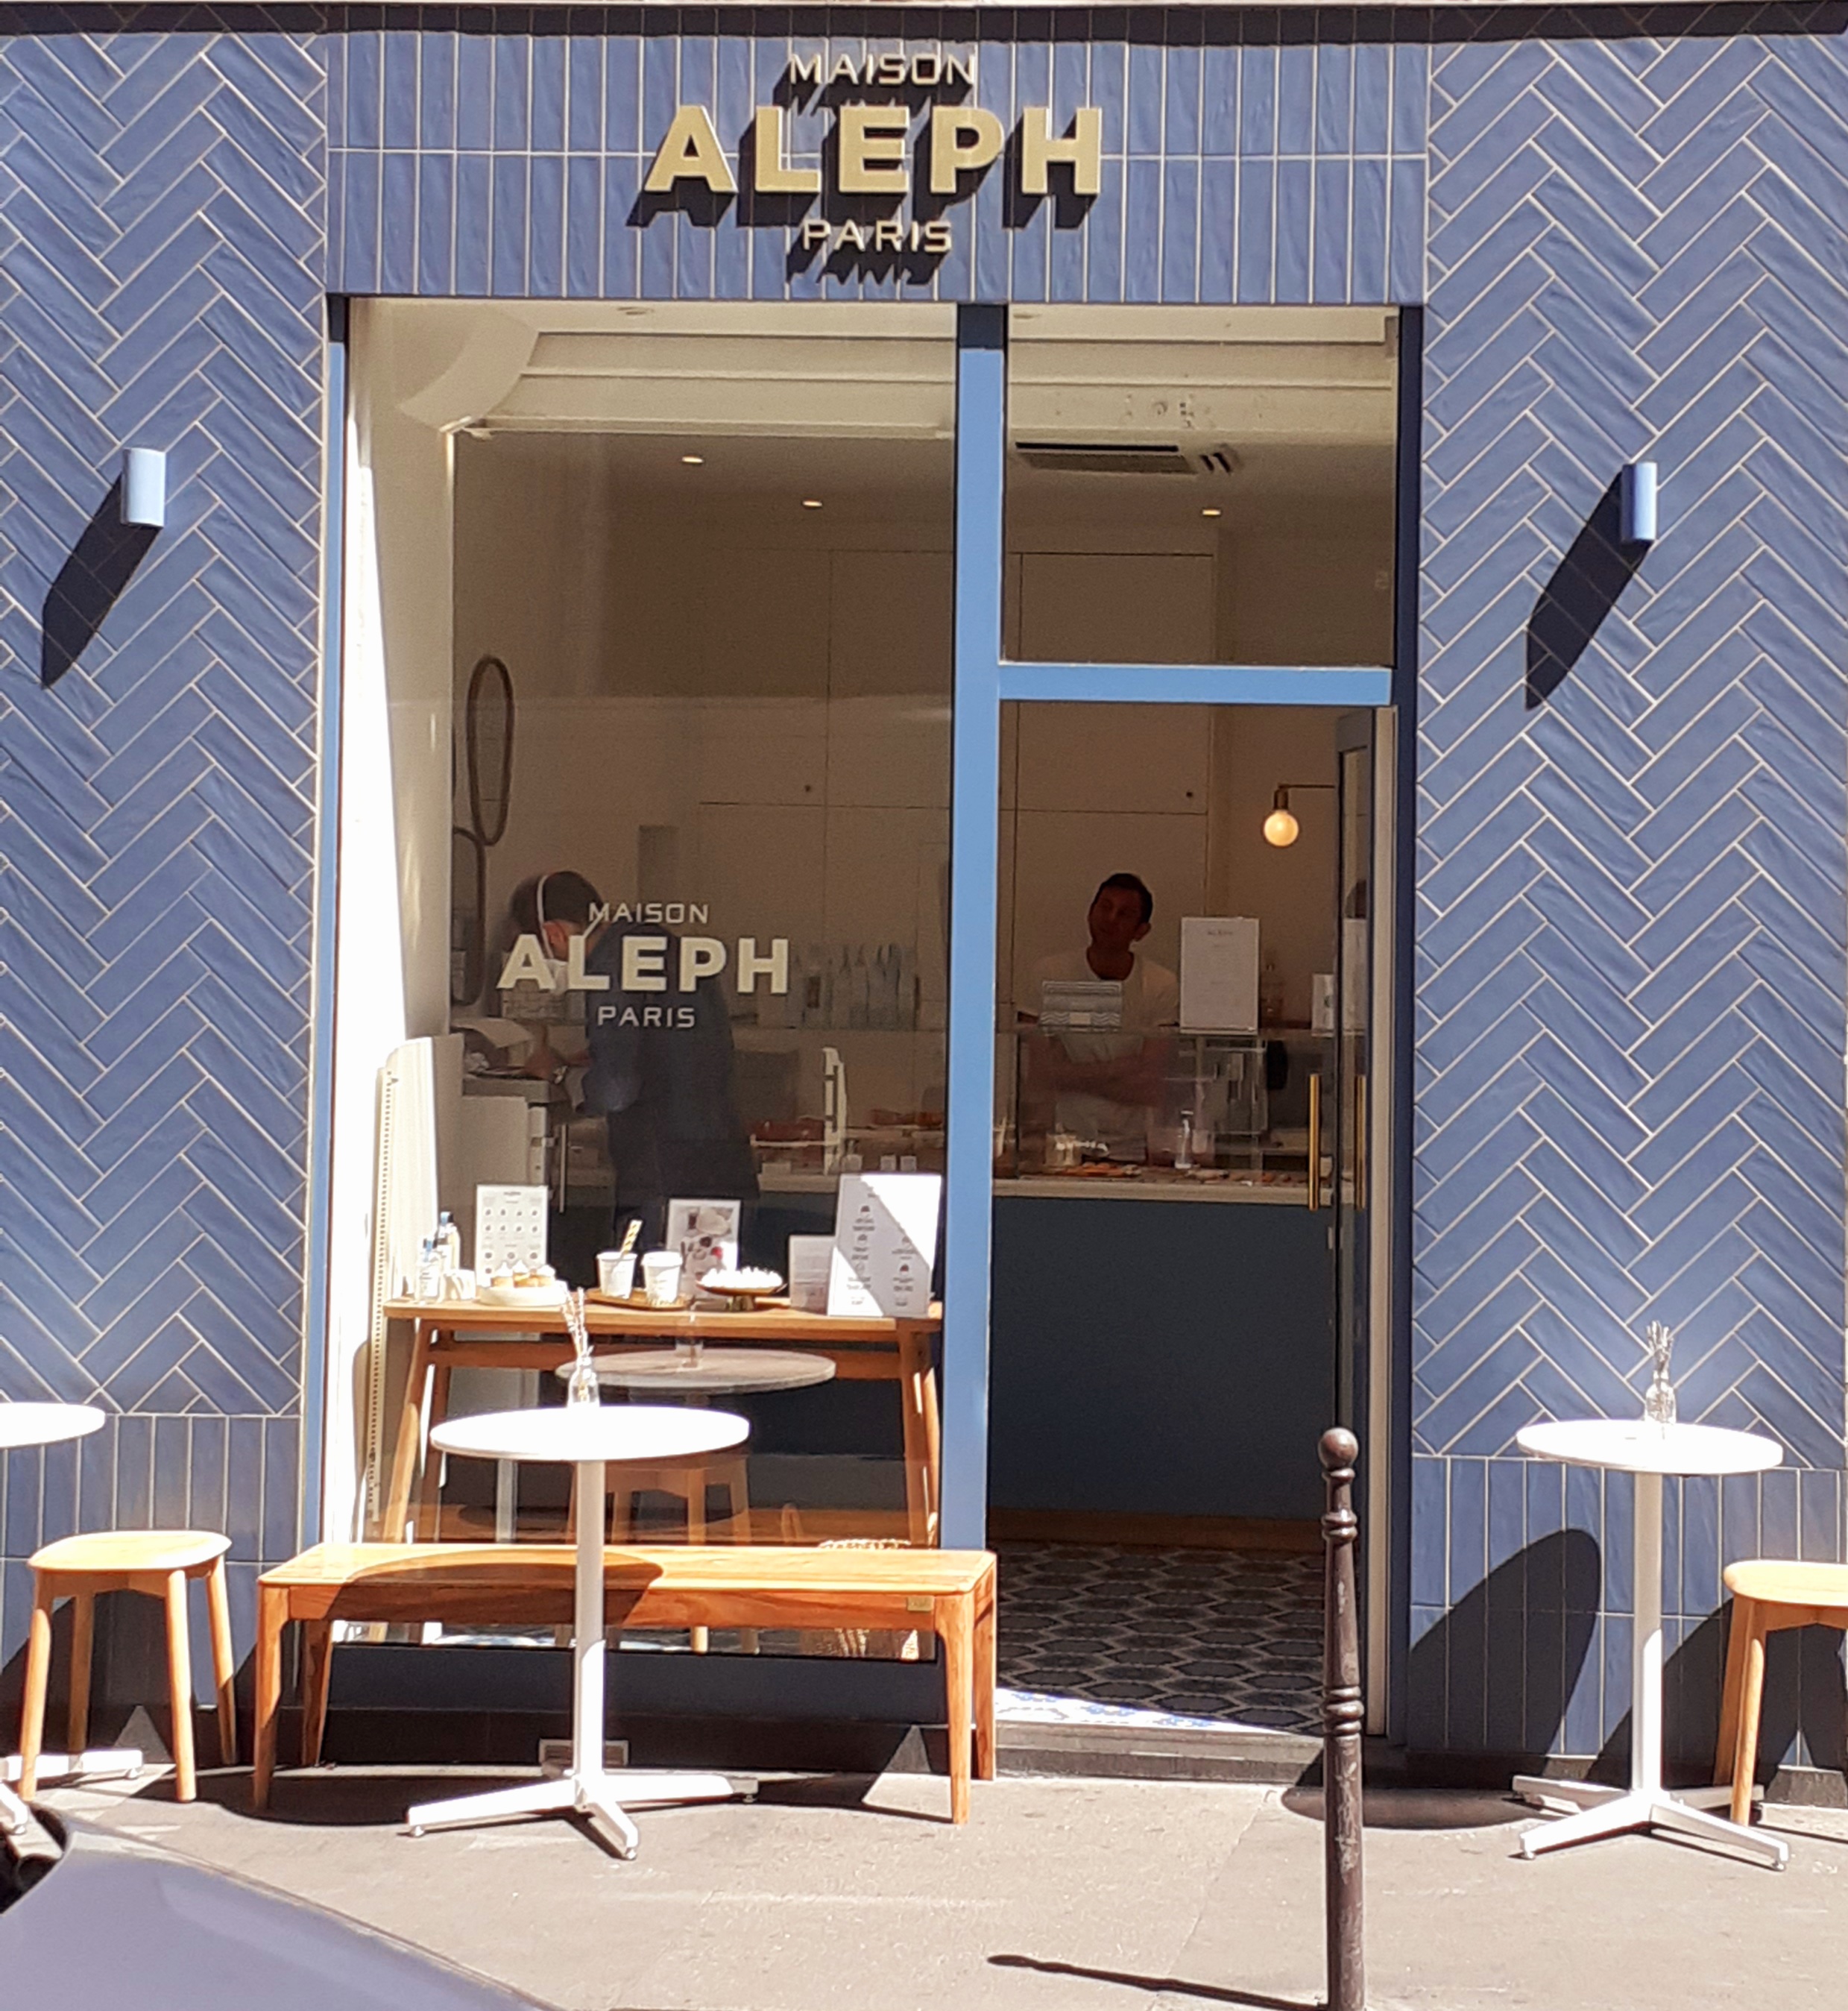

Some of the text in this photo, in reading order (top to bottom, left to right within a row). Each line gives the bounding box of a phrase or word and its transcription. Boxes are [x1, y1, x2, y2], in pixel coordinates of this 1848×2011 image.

[789, 54, 977, 85] MAISON
[644, 104, 1103, 195] ALEPH
[803, 221, 953, 253] PARIS
[588, 902, 709, 924] MAISON
[496, 934, 789, 994] ALEPH
[597, 1005, 696, 1028] PARIS
